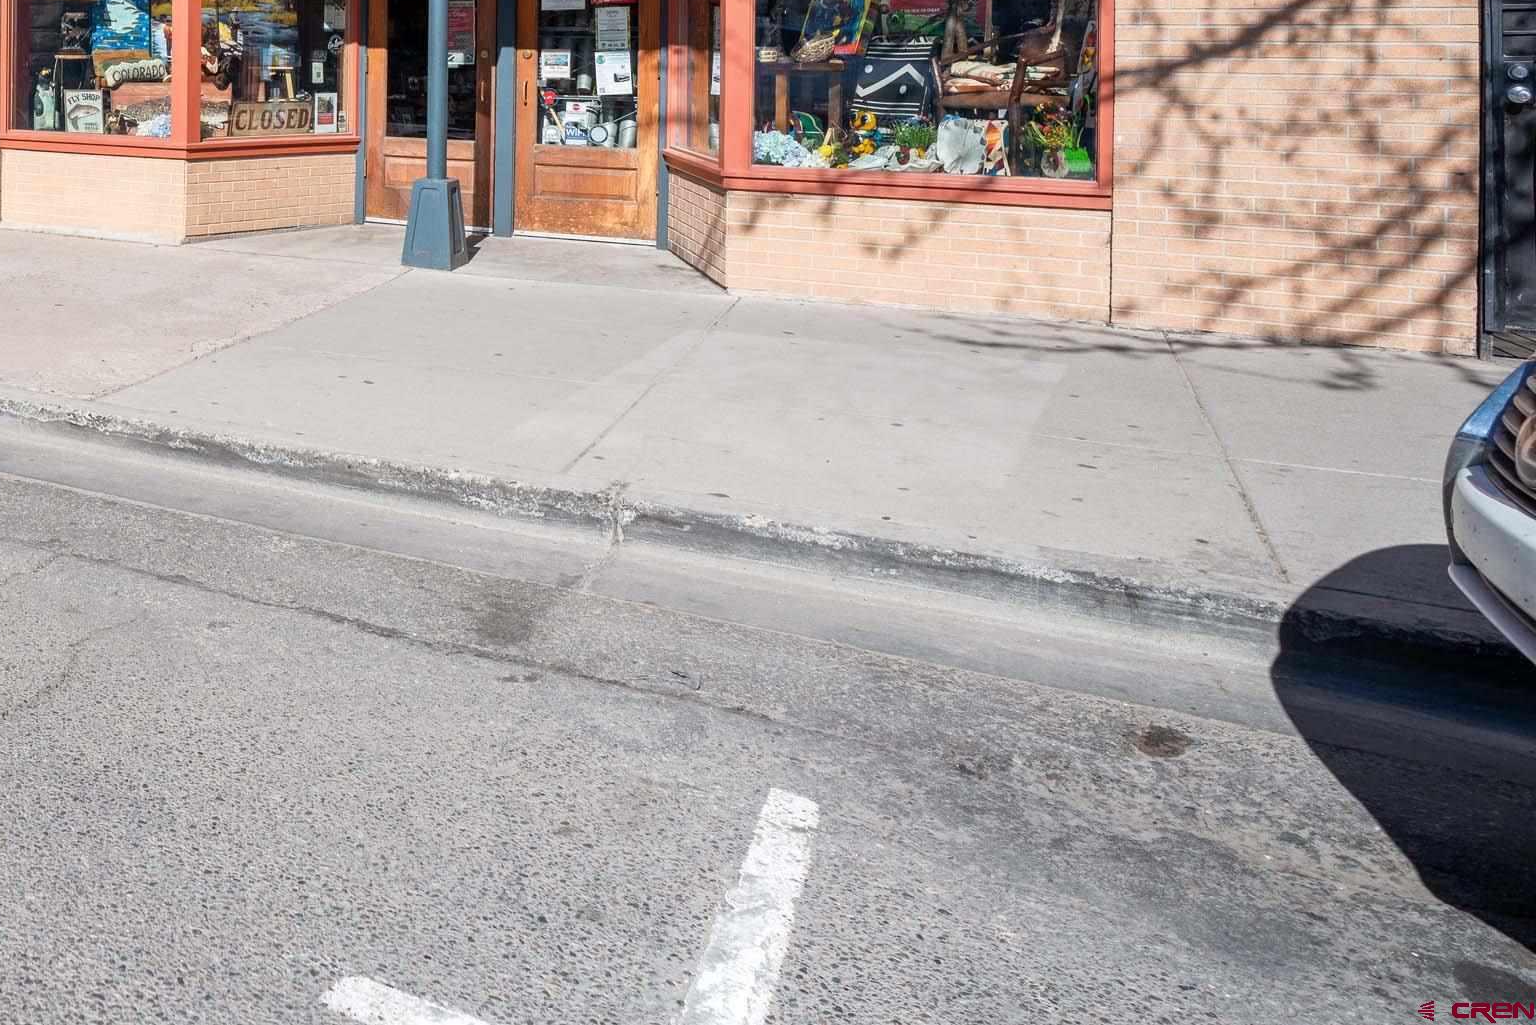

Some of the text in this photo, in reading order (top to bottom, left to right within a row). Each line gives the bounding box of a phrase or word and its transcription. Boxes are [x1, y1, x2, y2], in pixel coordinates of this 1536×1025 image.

[112, 63, 166, 83] COLORADO
[67, 92, 101, 105] FLY SHOP
[235, 107, 312, 130] CLOSED
